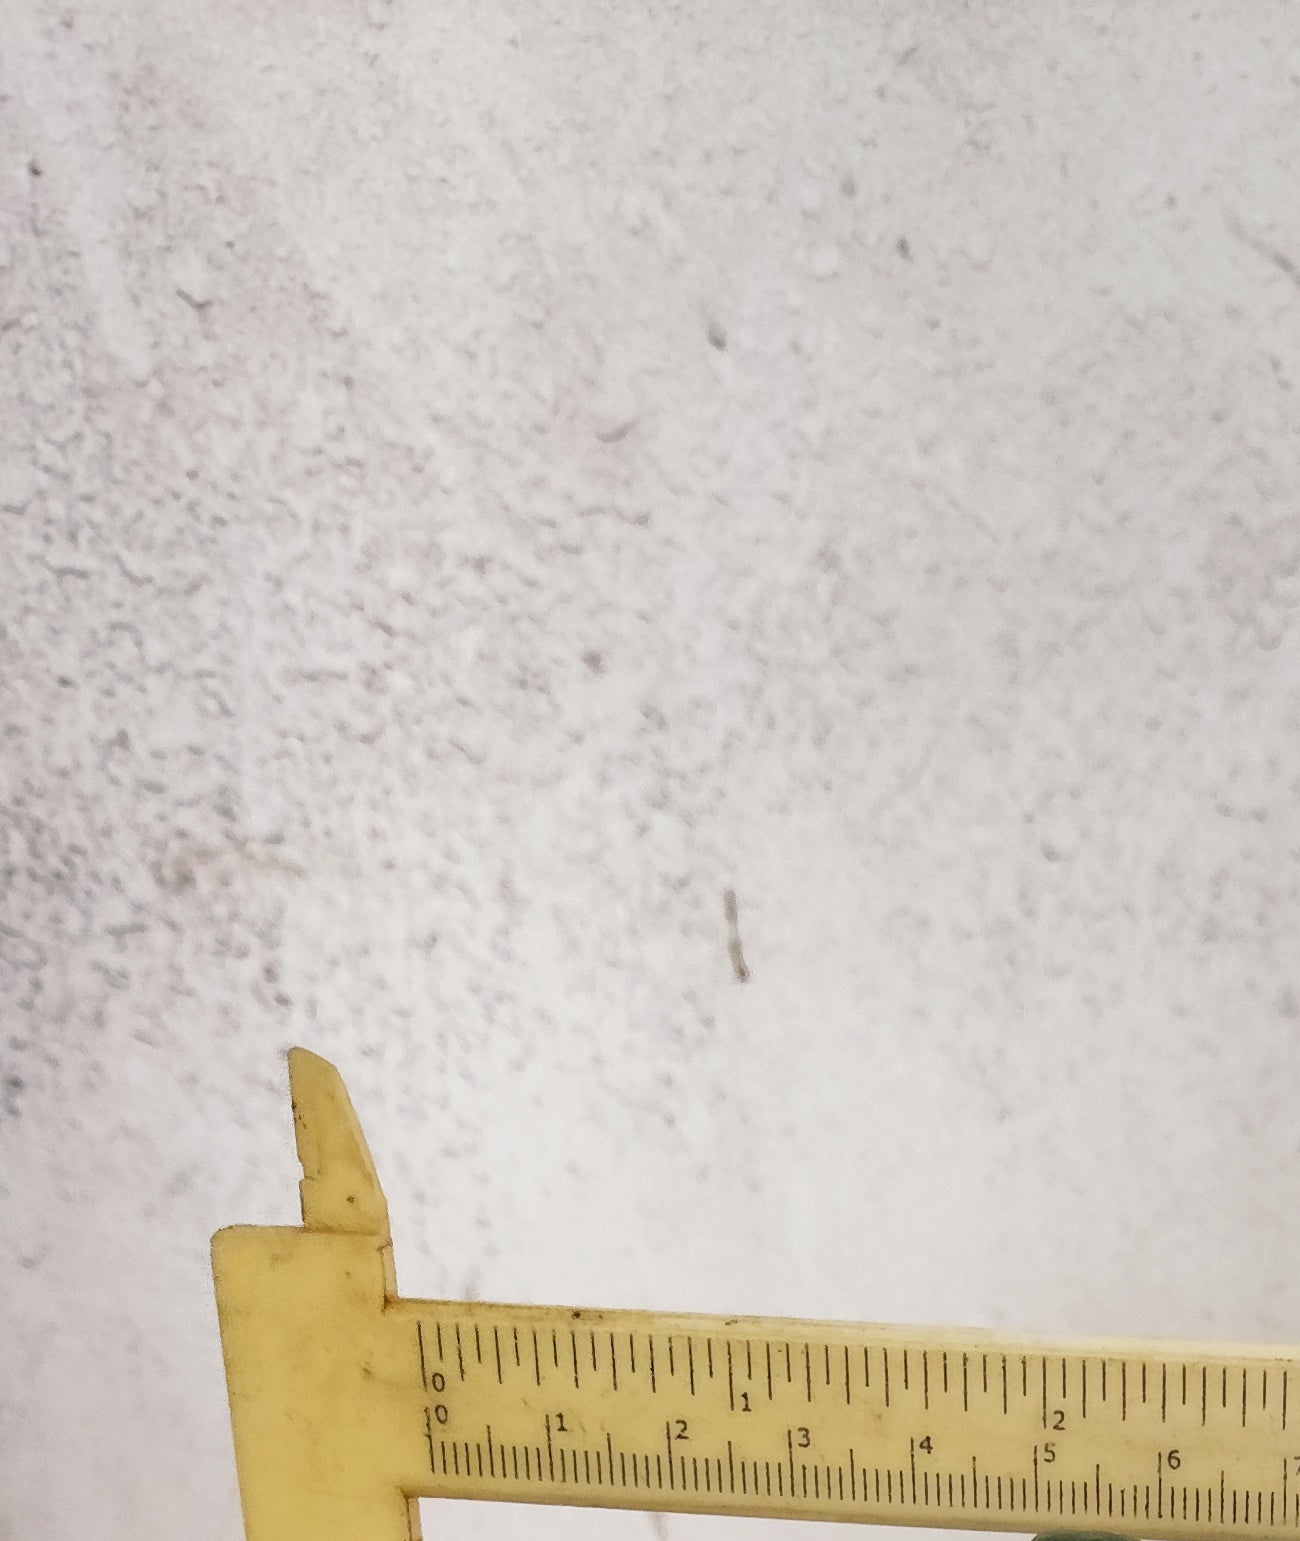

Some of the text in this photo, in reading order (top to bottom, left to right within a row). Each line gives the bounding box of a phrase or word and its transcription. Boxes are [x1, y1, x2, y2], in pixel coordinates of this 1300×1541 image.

[431, 1372, 446, 1392] 0
[741, 1393, 752, 1412] 1
[1052, 1411, 1066, 1430] 2
[435, 1405, 449, 1424] 0
[556, 1413, 567, 1432] 1
[675, 1420, 689, 1440] 2
[797, 1428, 811, 1448] 3
[918, 1435, 934, 1454] 4
[1044, 1443, 1056, 1463] 5
[1167, 1449, 1182, 1470] 6
